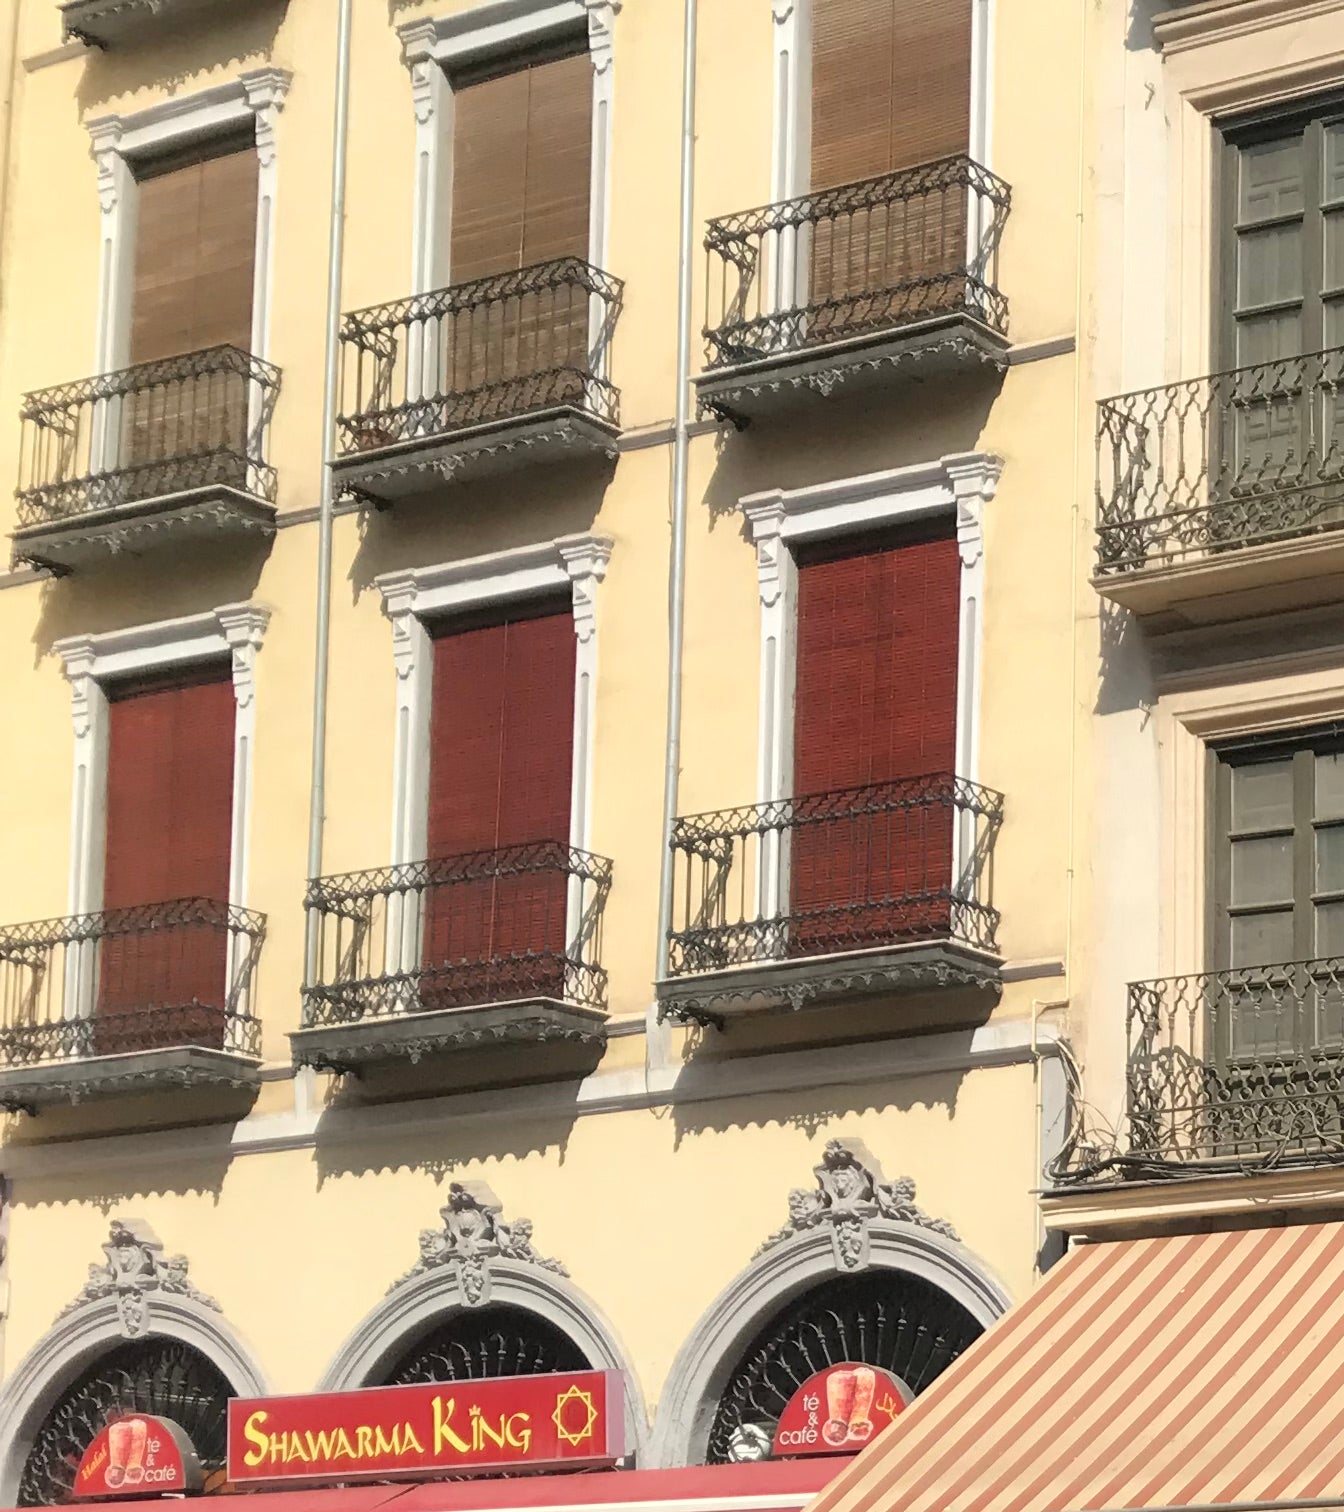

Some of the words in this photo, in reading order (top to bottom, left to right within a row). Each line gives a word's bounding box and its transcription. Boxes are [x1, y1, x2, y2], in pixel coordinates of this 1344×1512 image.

[803, 1392, 820, 1411] té
[808, 1412, 819, 1427] &
[146, 1436, 160, 1453] té
[243, 1410, 425, 1466] SHAWARMA
[779, 1426, 819, 1446] café
[81, 1442, 107, 1481] Halal
[146, 1454, 155, 1467] &
[144, 1464, 176, 1483] café
